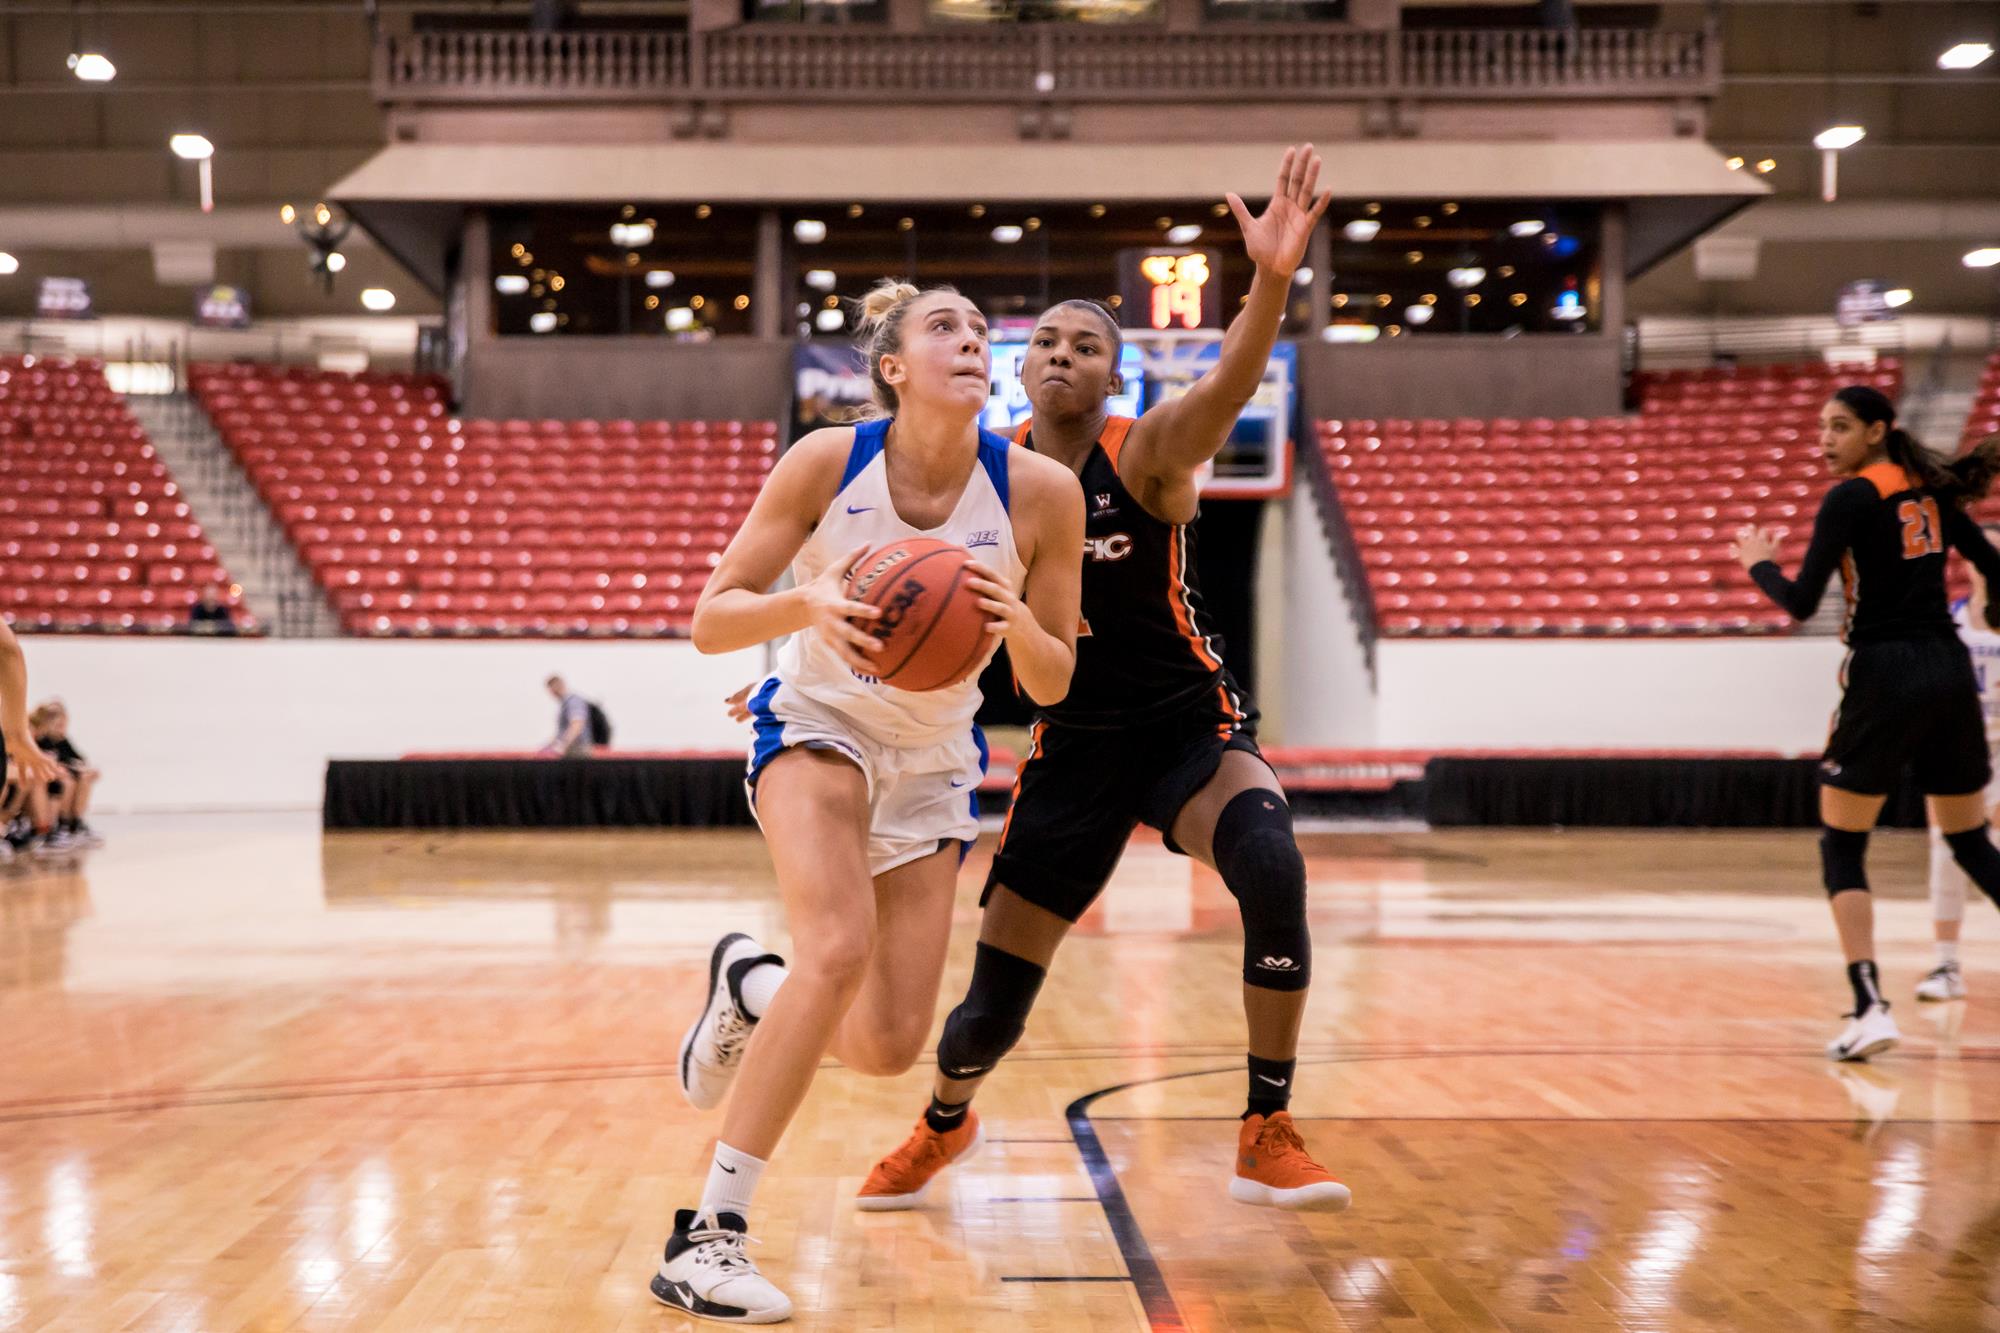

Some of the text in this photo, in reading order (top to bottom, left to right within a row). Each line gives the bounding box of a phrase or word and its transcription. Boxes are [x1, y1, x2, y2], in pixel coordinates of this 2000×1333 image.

[1151, 284, 1202, 330] 19
[966, 530, 999, 545] NEC
[1898, 496, 1943, 560] 21
